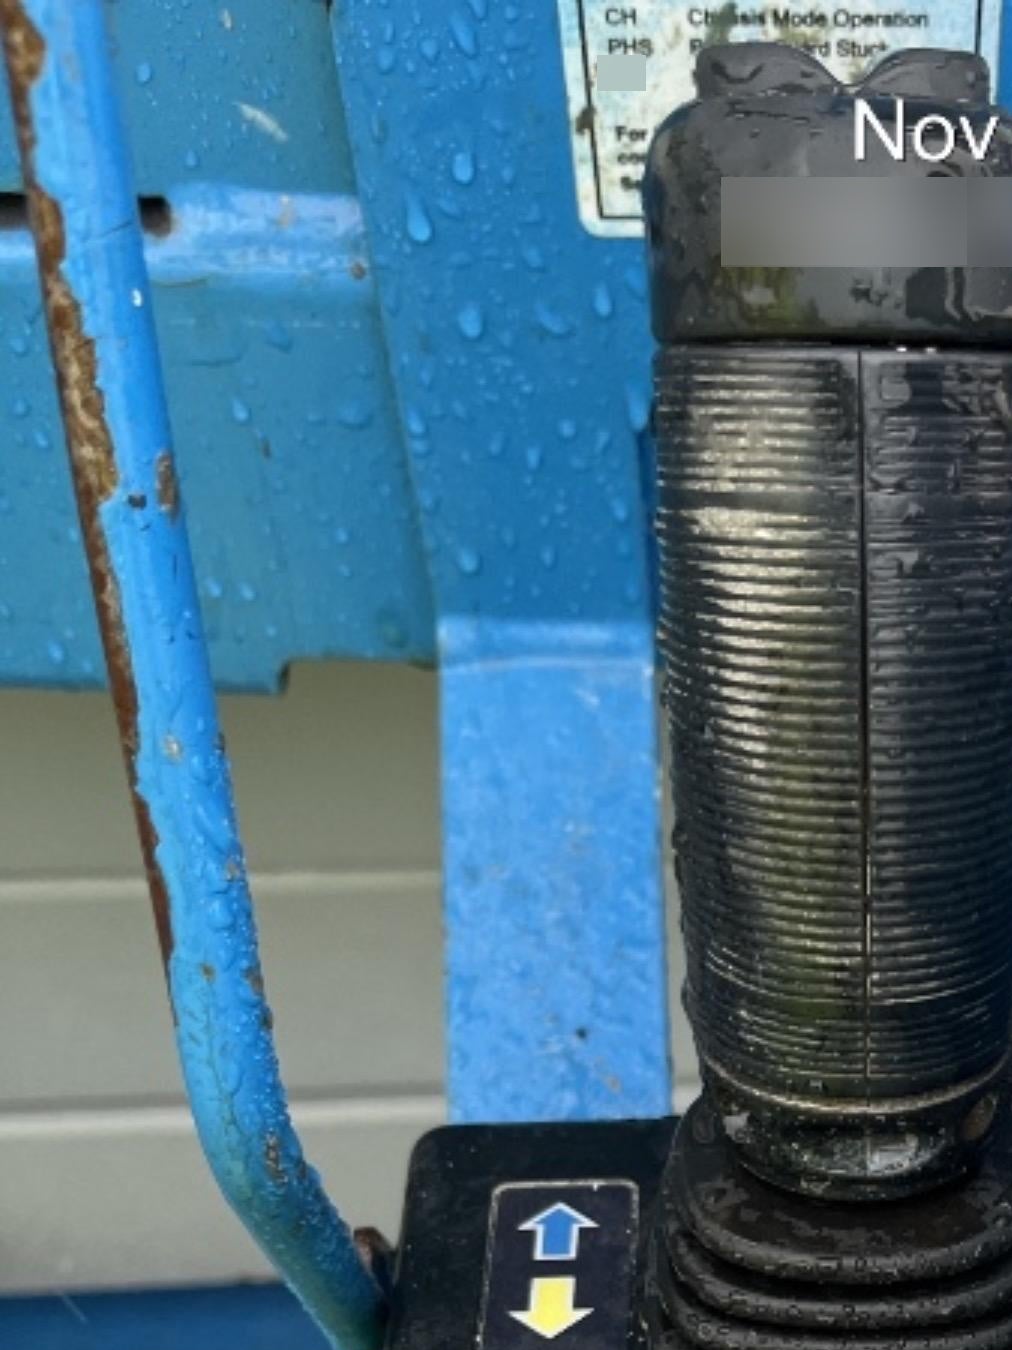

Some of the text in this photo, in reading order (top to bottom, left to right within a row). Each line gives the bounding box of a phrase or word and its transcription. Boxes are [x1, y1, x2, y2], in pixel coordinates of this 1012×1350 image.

[605, 8, 637, 25] CH
[772, 8, 827, 26] Mode
[833, 8, 929, 28] Operation
